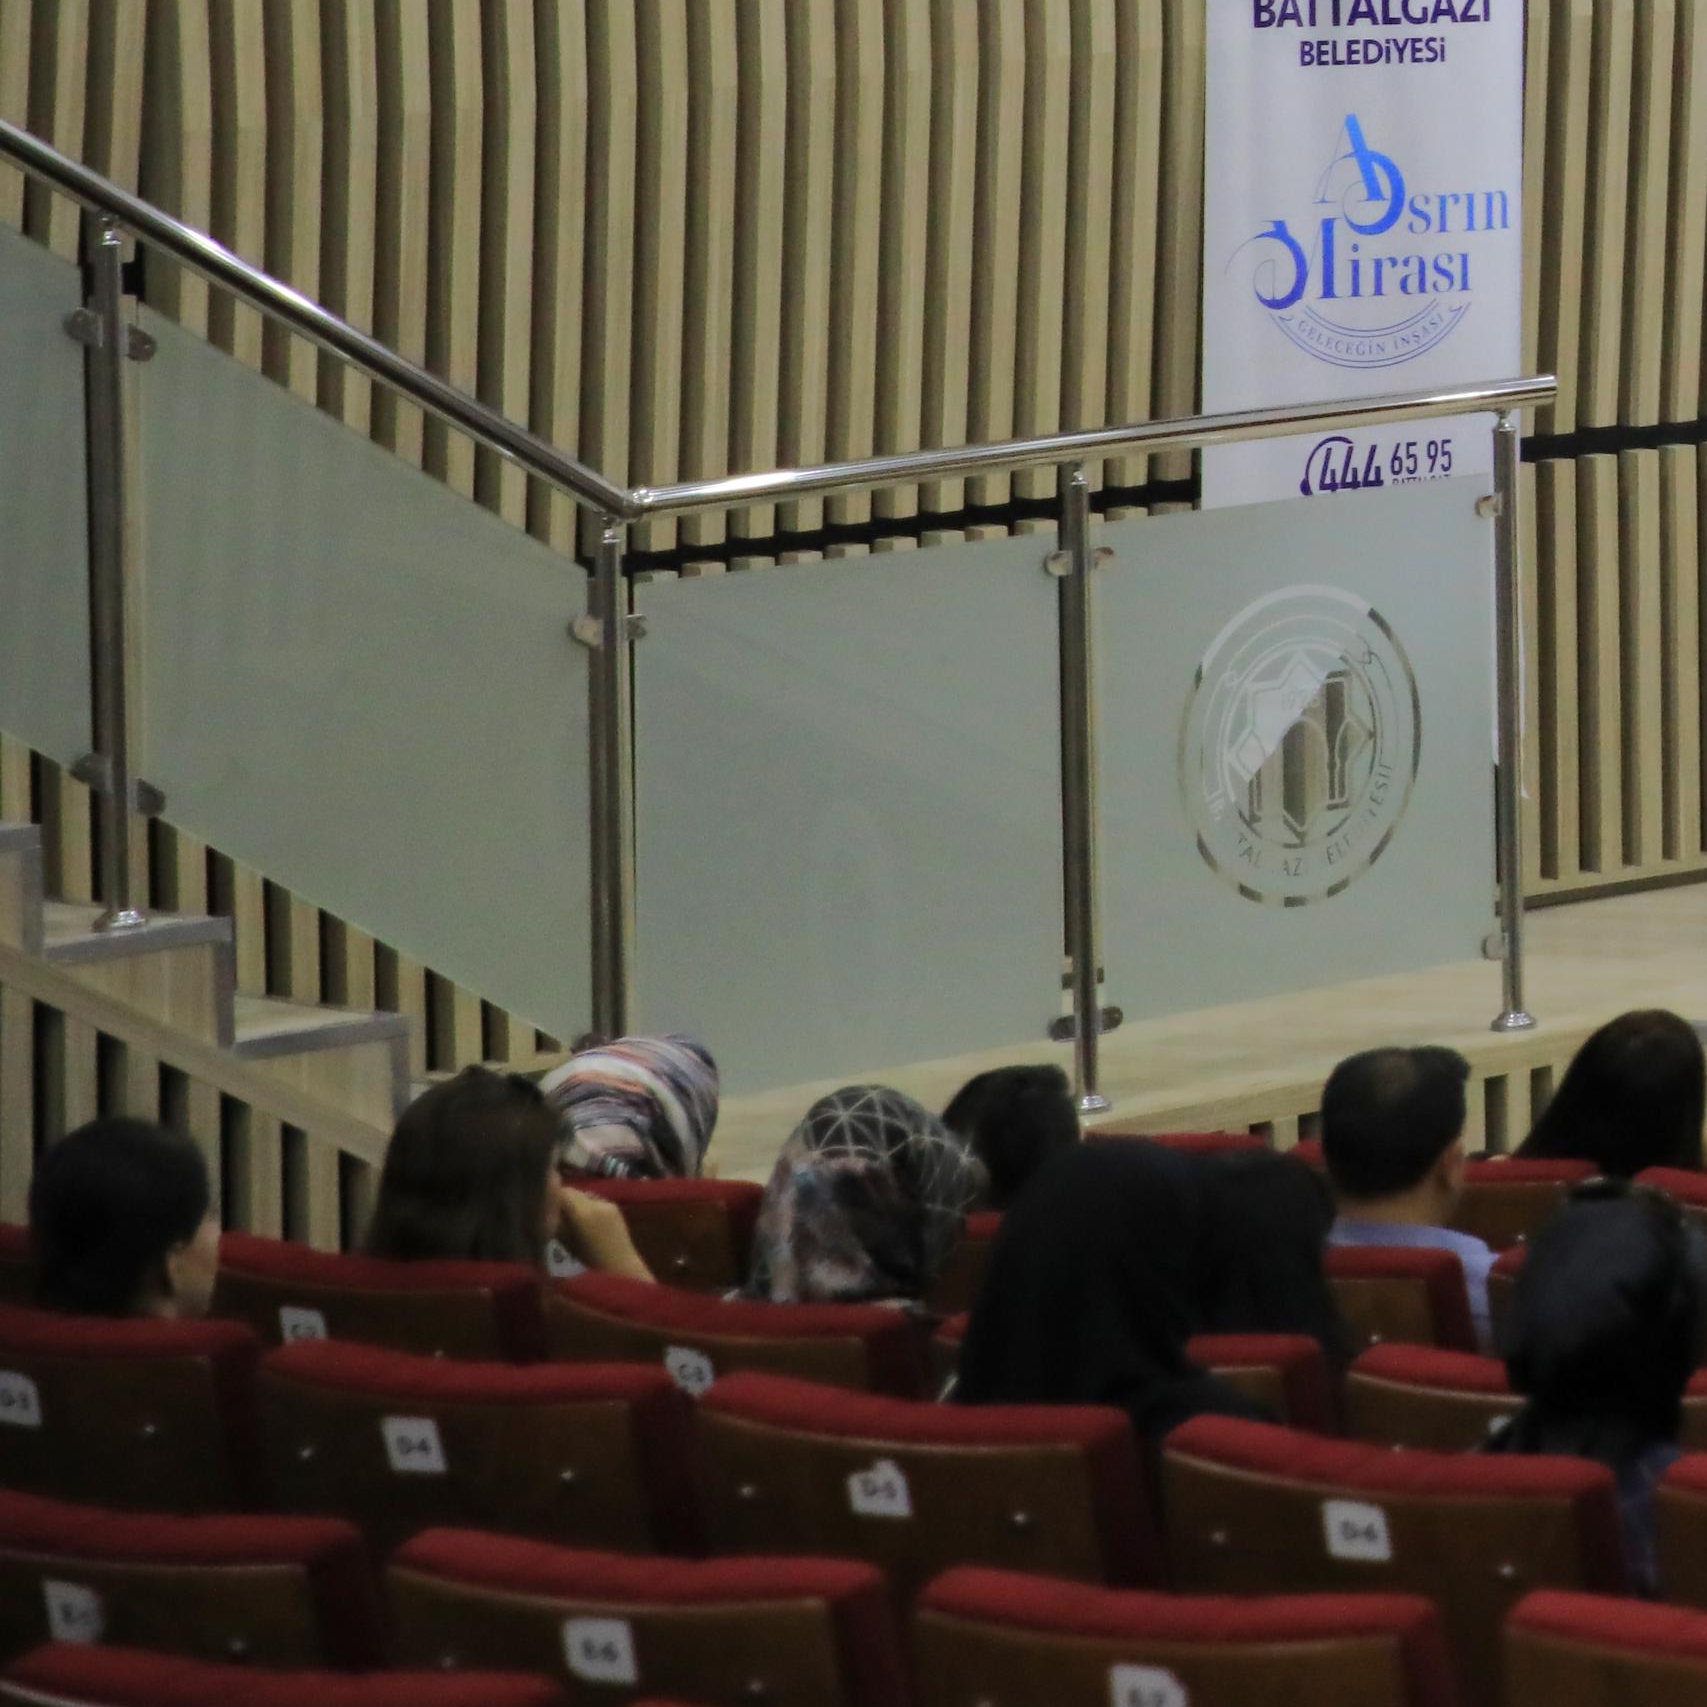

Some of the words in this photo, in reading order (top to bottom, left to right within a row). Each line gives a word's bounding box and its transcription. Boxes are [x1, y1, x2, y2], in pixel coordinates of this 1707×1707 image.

[1297, 318, 1386, 356] GELECEĞİN
[1318, 444, 1385, 492] 444
[1390, 441, 1418, 476] 65
[1426, 439, 1453, 474] 95
